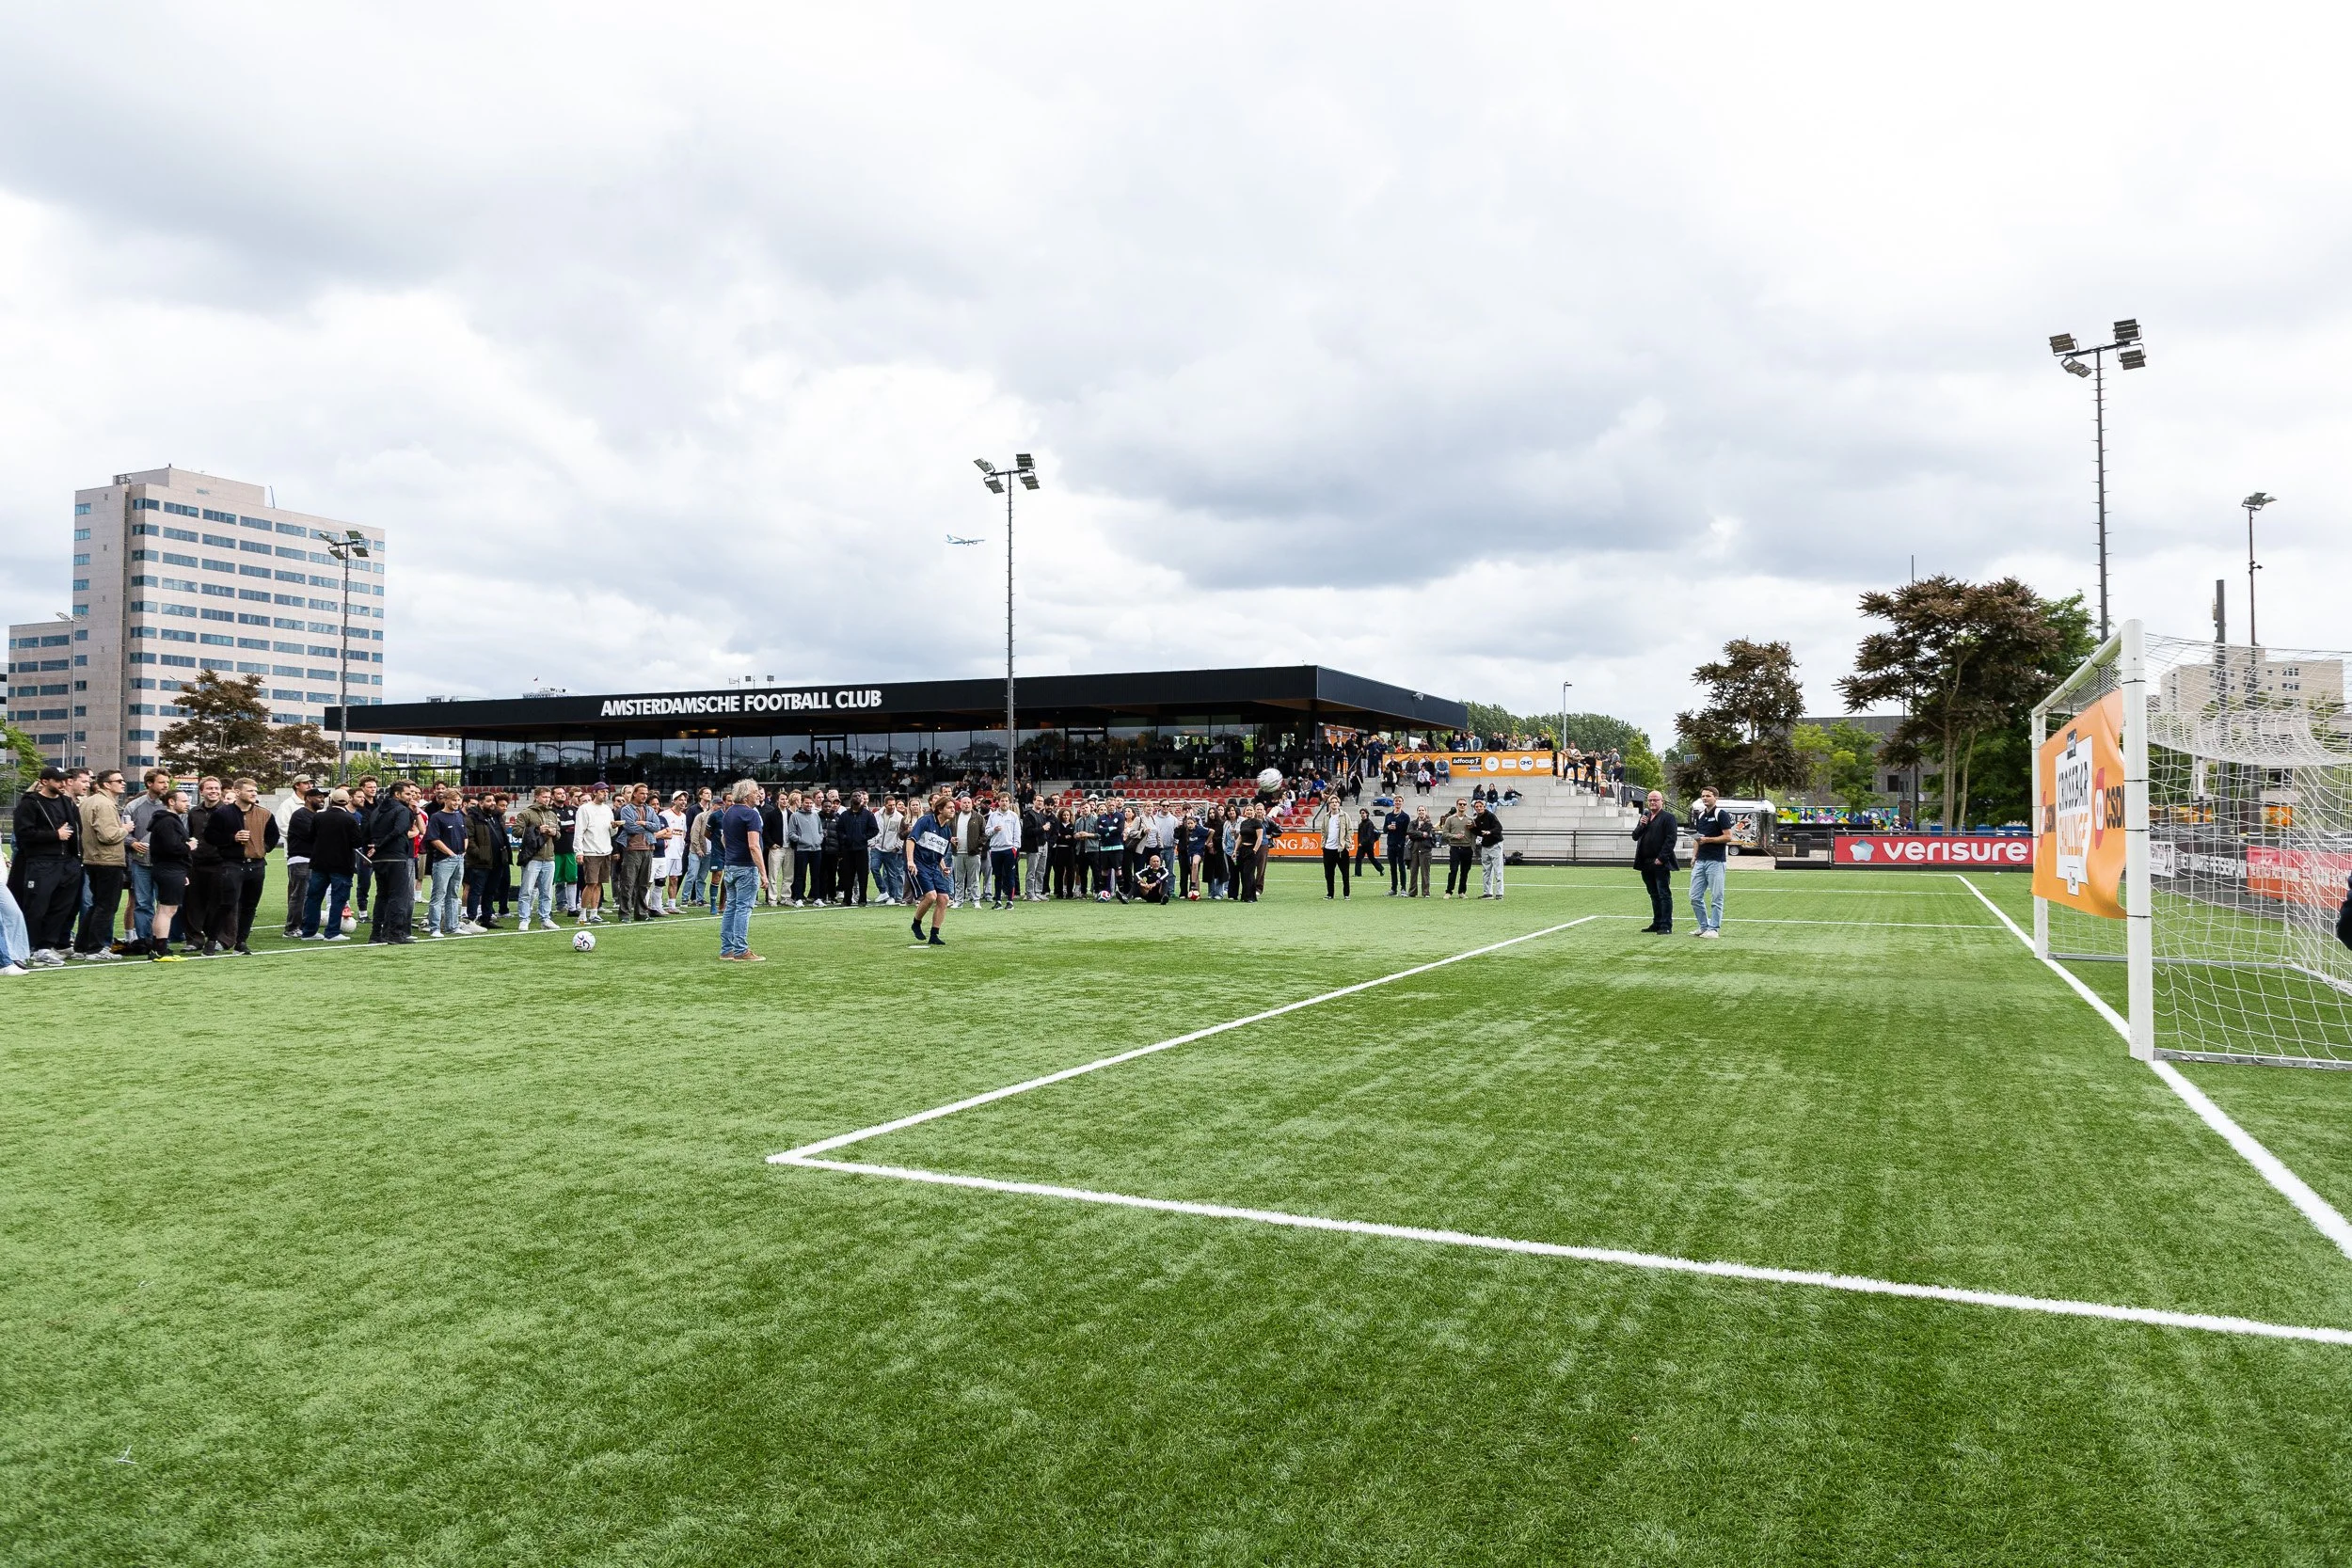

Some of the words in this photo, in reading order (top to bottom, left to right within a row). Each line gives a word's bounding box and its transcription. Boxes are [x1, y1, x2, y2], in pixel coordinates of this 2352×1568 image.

[601, 695, 740, 716] AMSTERDAMSCHE
[744, 691, 832, 712] FOOTBALL
[835, 689, 882, 708] CLUB
[2058, 761, 2090, 812] CROSSBAR
[1883, 841, 2028, 862] verisure
